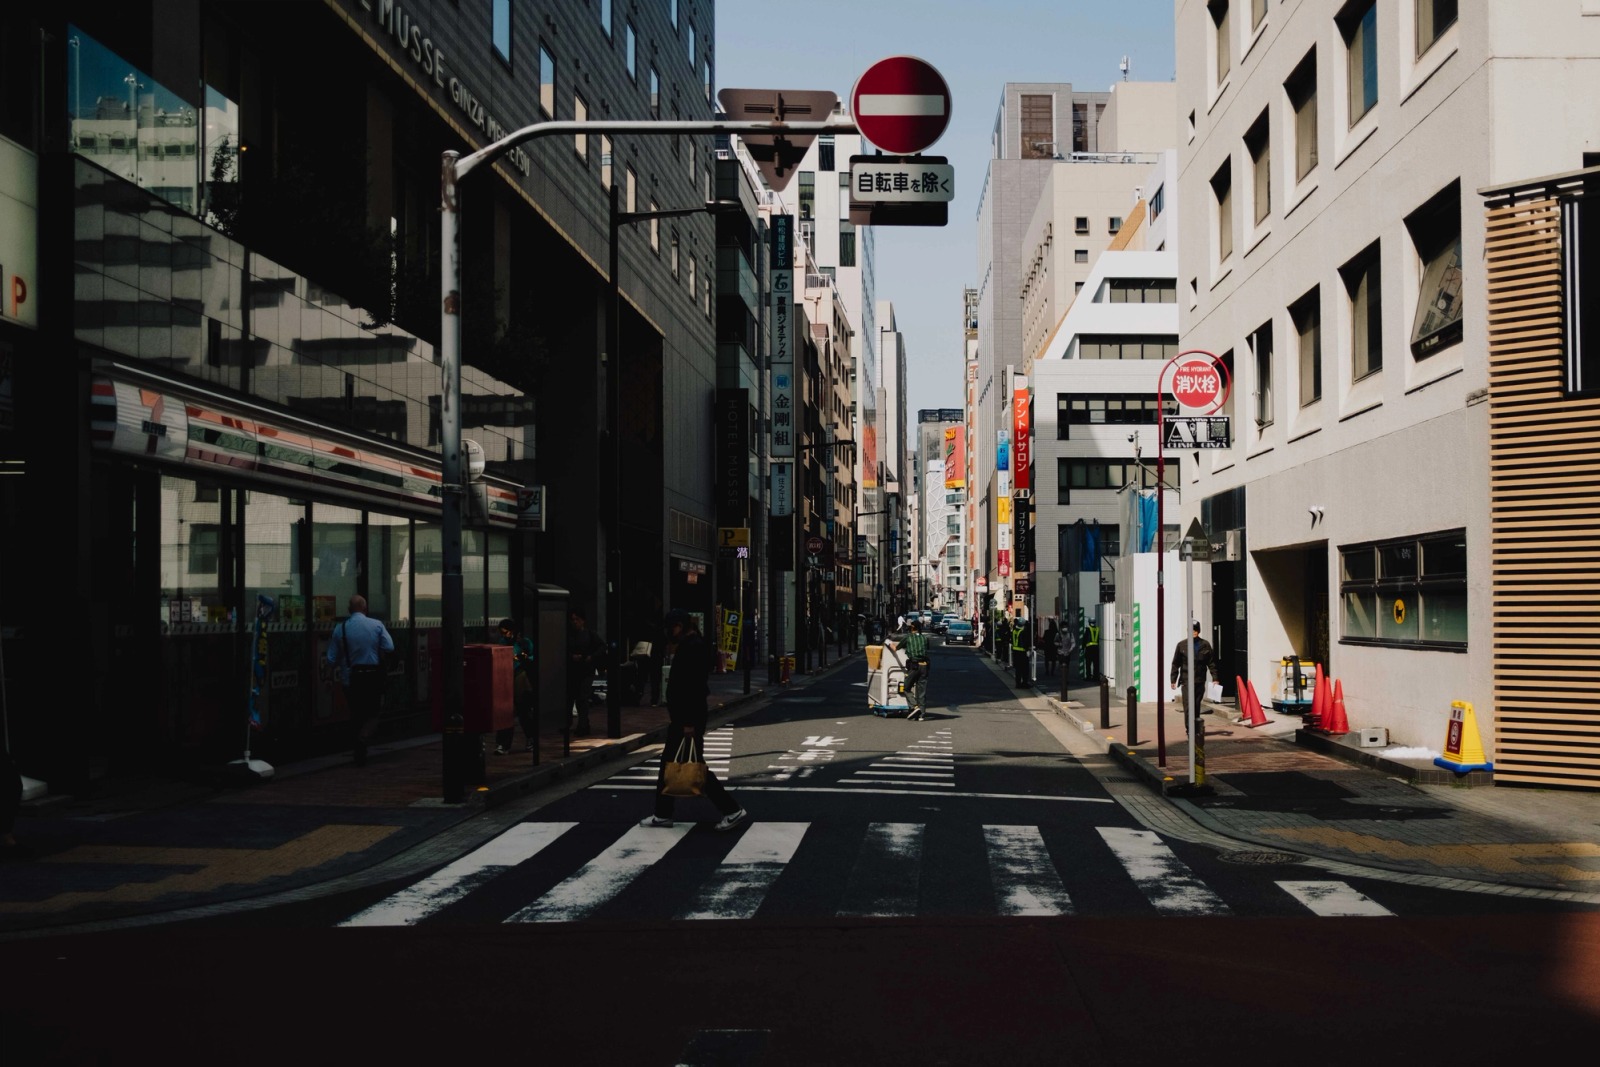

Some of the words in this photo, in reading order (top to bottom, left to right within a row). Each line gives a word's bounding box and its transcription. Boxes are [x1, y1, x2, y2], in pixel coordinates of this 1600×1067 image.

[378, 0, 445, 88] MUSSE
[450, 77, 485, 132] GINZA
[858, 171, 950, 194] 自転車を除く
[11, 275, 27, 319] P
[777, 296, 786, 359] 東興ジオテック
[1176, 374, 1217, 394] 消火栓
[727, 400, 738, 449] HOTEL
[774, 393, 791, 446] 金剛組
[1016, 398, 1027, 472] アントレサロン
[1167, 421, 1216, 443] AL
[727, 455, 738, 507] MUSSE
[721, 529, 735, 546] P
[736, 546, 749, 559] 満
[1018, 511, 1026, 571] ゴリラクリニック
